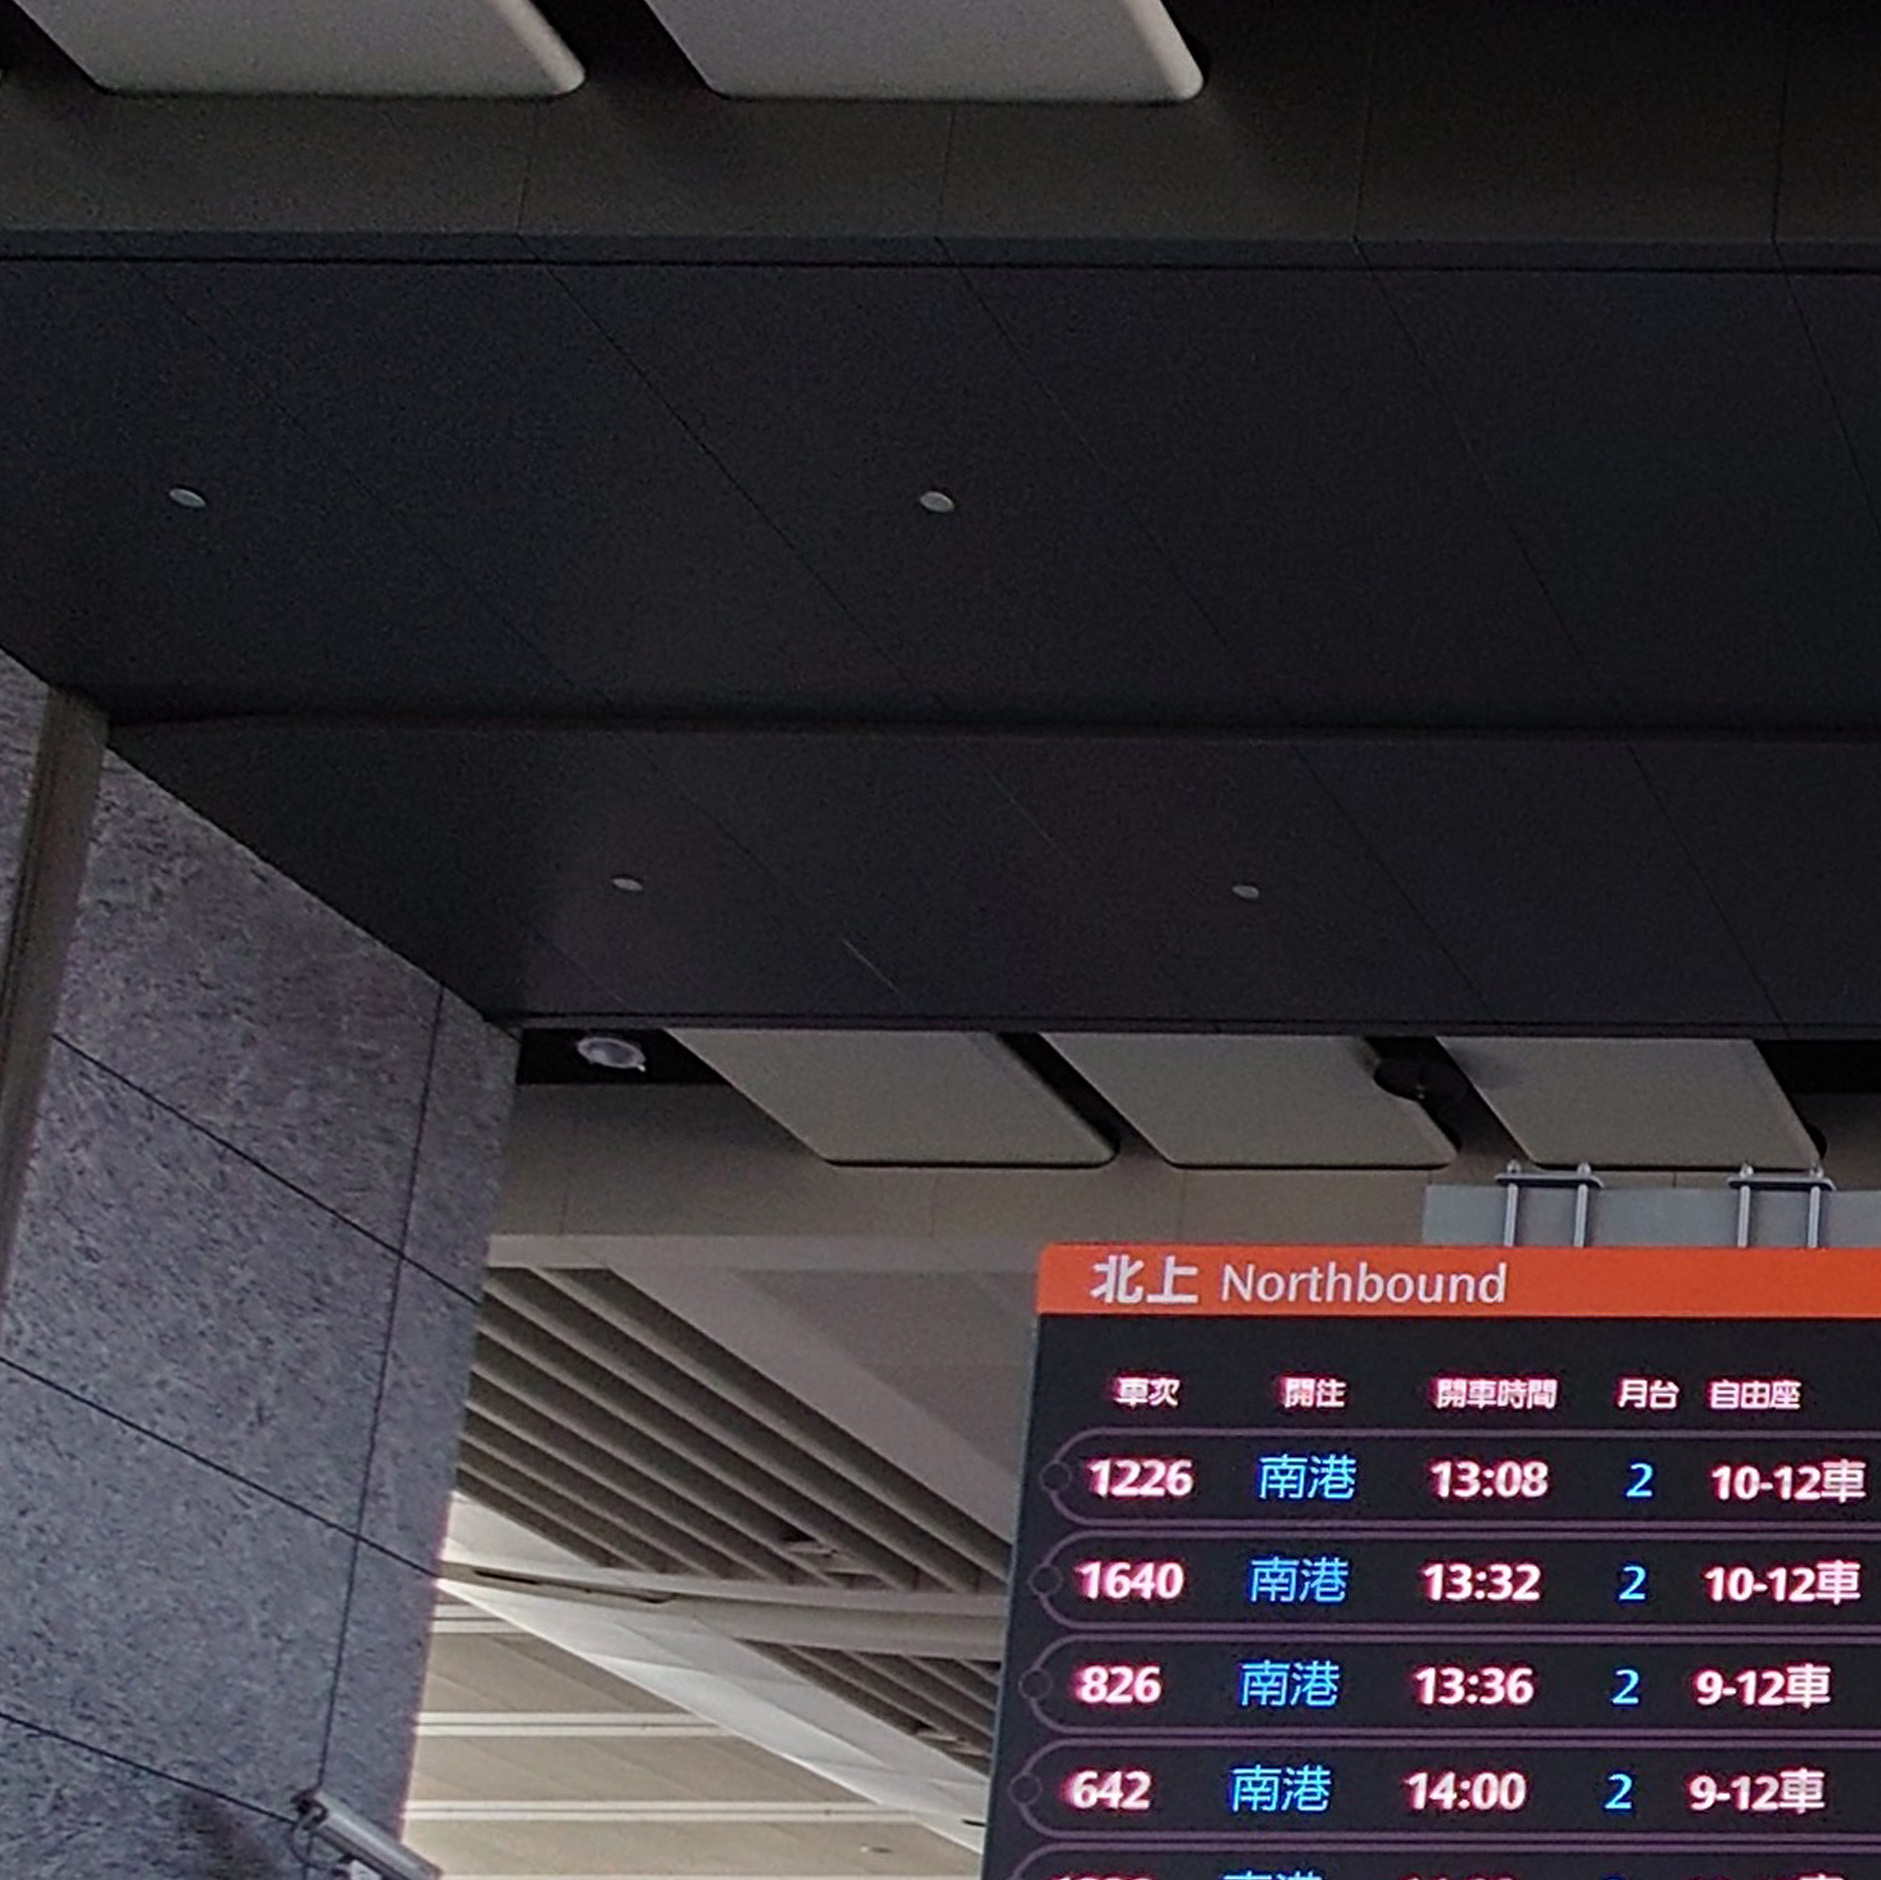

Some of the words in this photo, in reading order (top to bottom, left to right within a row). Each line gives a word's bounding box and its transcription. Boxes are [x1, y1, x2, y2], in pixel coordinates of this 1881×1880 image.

[1089, 1254, 1198, 1304] 北上
[1221, 1261, 1507, 1303] Northbound
[1114, 1376, 1181, 1407] 車次
[1280, 1376, 1346, 1408] 開往
[1434, 1377, 1558, 1410] 開車時間
[1617, 1378, 1680, 1410] 月台
[1708, 1378, 1802, 1410] 自由座
[1086, 1458, 1194, 1497] 1226
[1258, 1453, 1357, 1500] 南港
[1430, 1460, 1549, 1499] 13:08
[1624, 1462, 1654, 1498] 2
[1710, 1458, 1866, 1504] 10-12車
[1074, 1560, 1185, 1600] 1640
[1249, 1555, 1349, 1603] 南港
[1422, 1562, 1541, 1601] 13:32
[1618, 1564, 1647, 1601] 2
[1704, 1558, 1861, 1605] 10-12車
[1075, 1665, 1162, 1705] 826
[1238, 1659, 1340, 1707] 南港
[1413, 1666, 1534, 1705] 13:36
[1610, 1668, 1640, 1705] 2
[1693, 1662, 1831, 1709] 9-12車
[1065, 1770, 1151, 1810] 642
[1229, 1763, 1332, 1812] 南港
[1404, 1771, 1527, 1810] 14:00
[1604, 1773, 1633, 1810] 2
[1687, 1767, 1826, 1815] 9-12車
